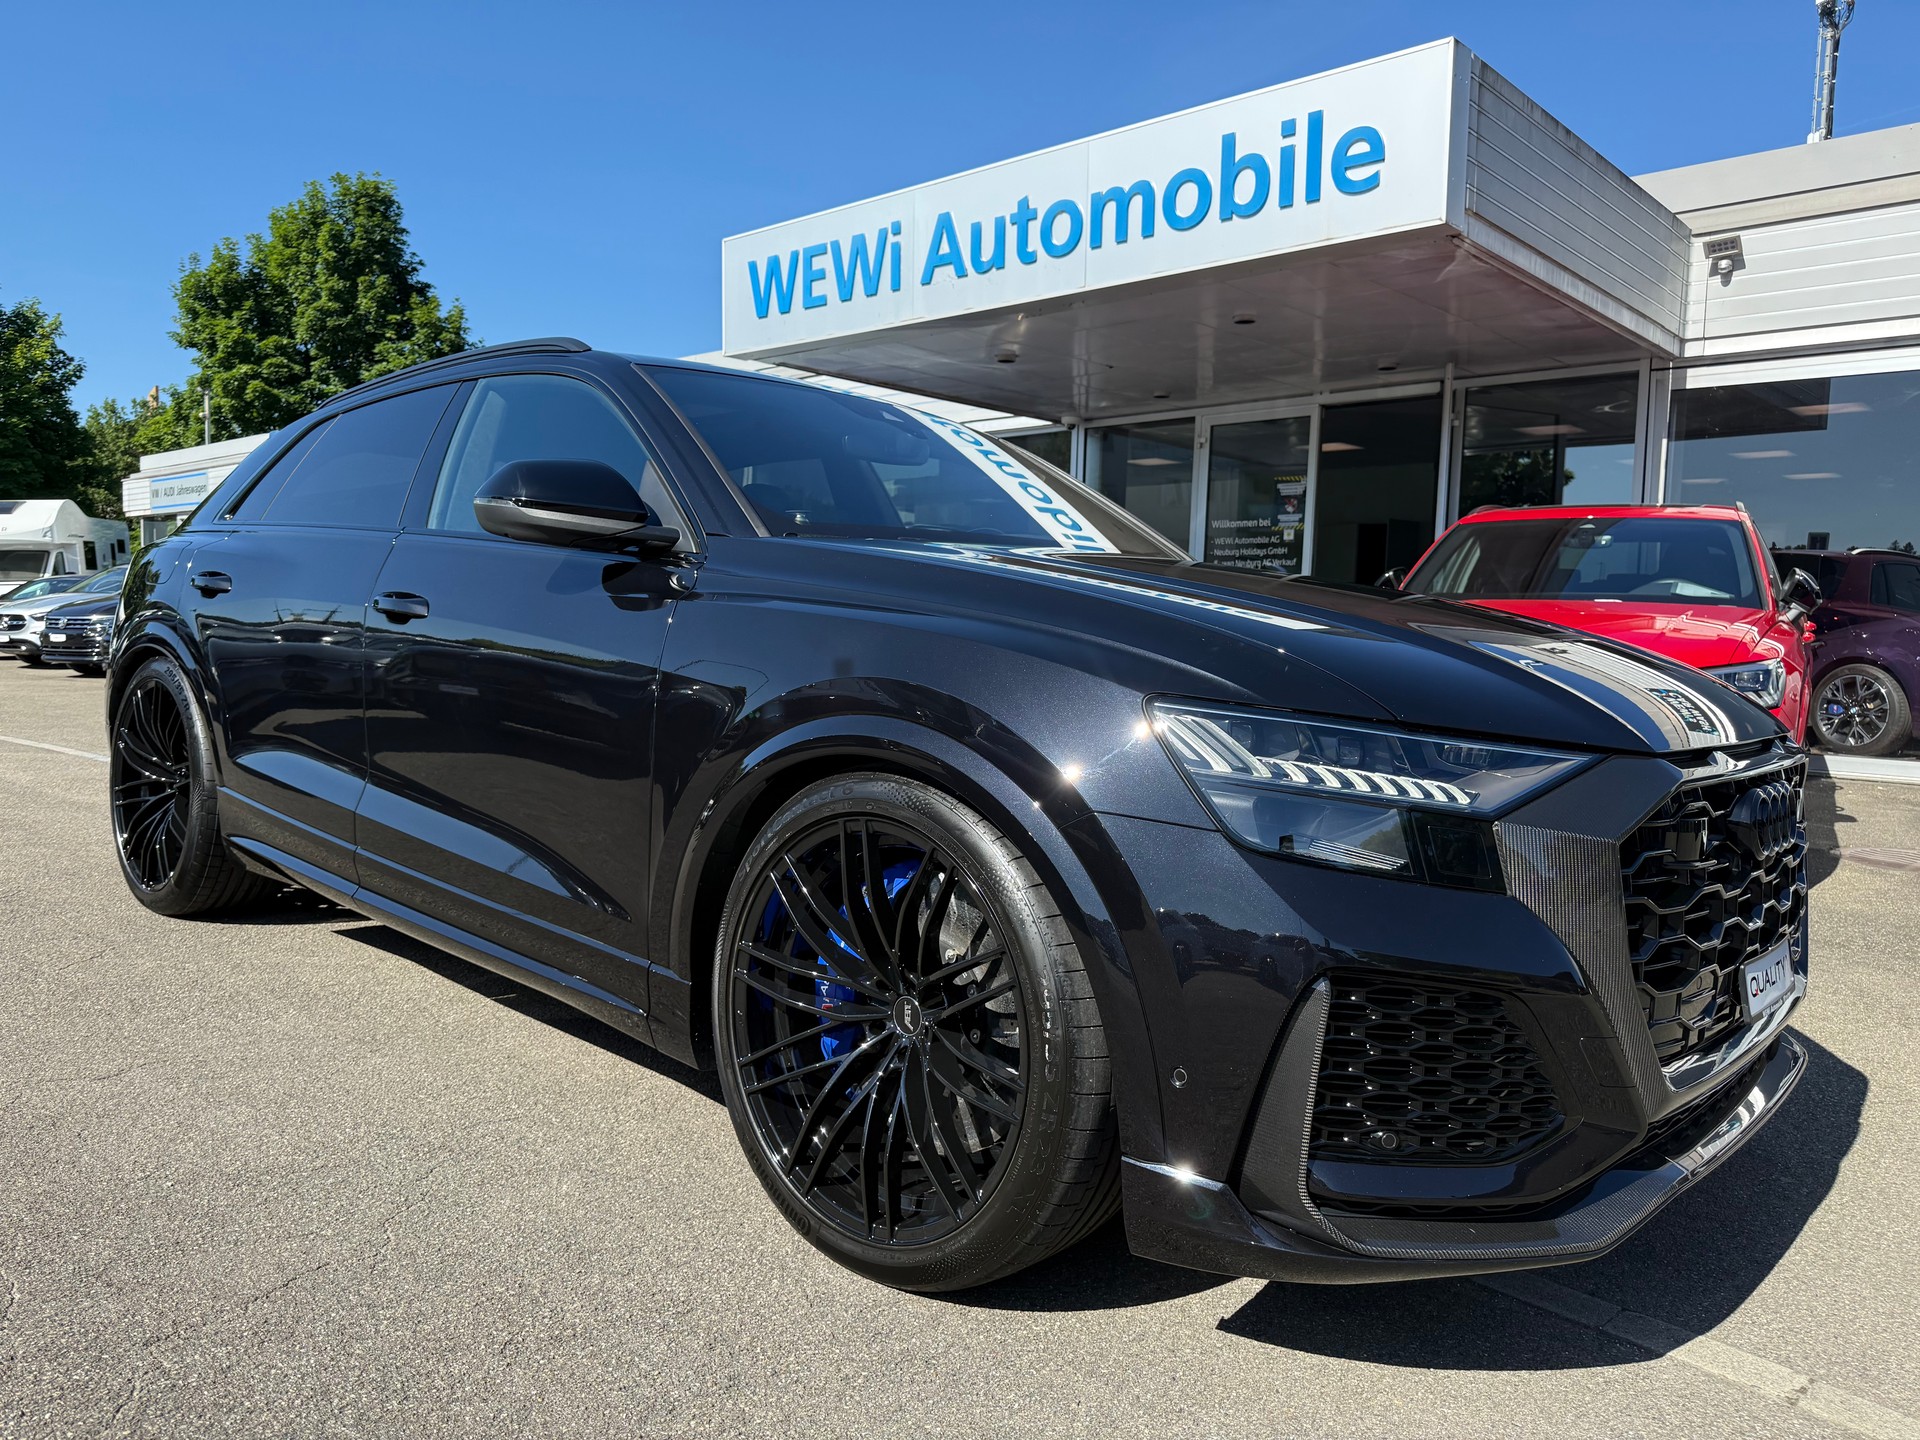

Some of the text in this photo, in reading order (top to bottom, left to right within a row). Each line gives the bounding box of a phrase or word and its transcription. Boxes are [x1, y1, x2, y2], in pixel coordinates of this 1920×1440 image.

[749, 109, 1386, 319] WEWi Automobile
[163, 486, 175, 497] AUDI
[176, 484, 207, 497] Jahreswagen
[1211, 519, 1258, 528] Willkommen
[1259, 517, 1271, 527] bei
[1235, 536, 1269, 544] Automobile
[1270, 535, 1280, 543] AG
[1213, 546, 1288, 557] Neuburg Holidays GmbH
[1235, 560, 1261, 569] Neuburg
[1273, 558, 1297, 567] Verkauf
[164, 666, 184, 696] 295/35
[181, 698, 191, 712] ZR
